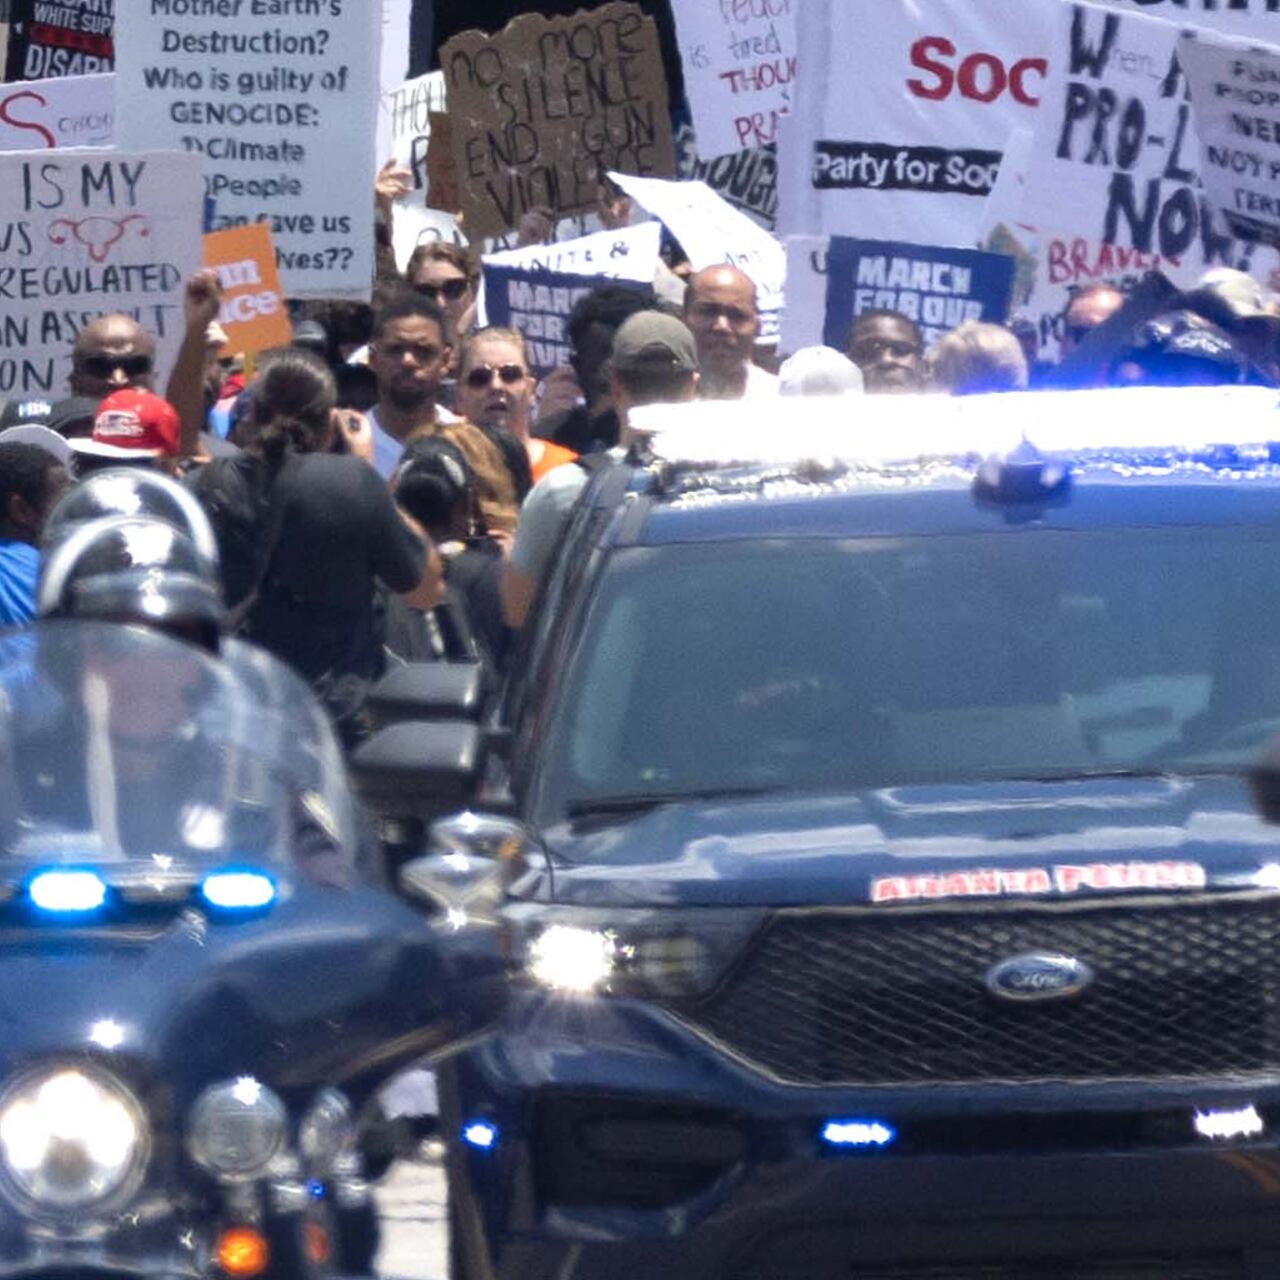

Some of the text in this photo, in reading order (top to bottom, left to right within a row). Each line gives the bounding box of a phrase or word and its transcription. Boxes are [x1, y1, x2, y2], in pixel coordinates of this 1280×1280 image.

[33, 1, 78, 31] WHITE
[161, 27, 330, 55] Destruction?
[23, 45, 115, 79] DISAR
[143, 65, 349, 98] Who is guilty of
[497, 54, 645, 124] SILENCE
[169, 101, 320, 127] GENOCIDE:
[465, 101, 657, 179] END GUN
[812, 150, 891, 189] Party
[893, 151, 941, 183] for
[1206, 145, 1263, 178] NOT
[24, 163, 65, 212] IS
[82, 160, 147, 207] MY
[322, 211, 351, 235] us
[856, 255, 972, 294] MARCH
[872, 861, 1206, 903] ATLANTA POLICE
